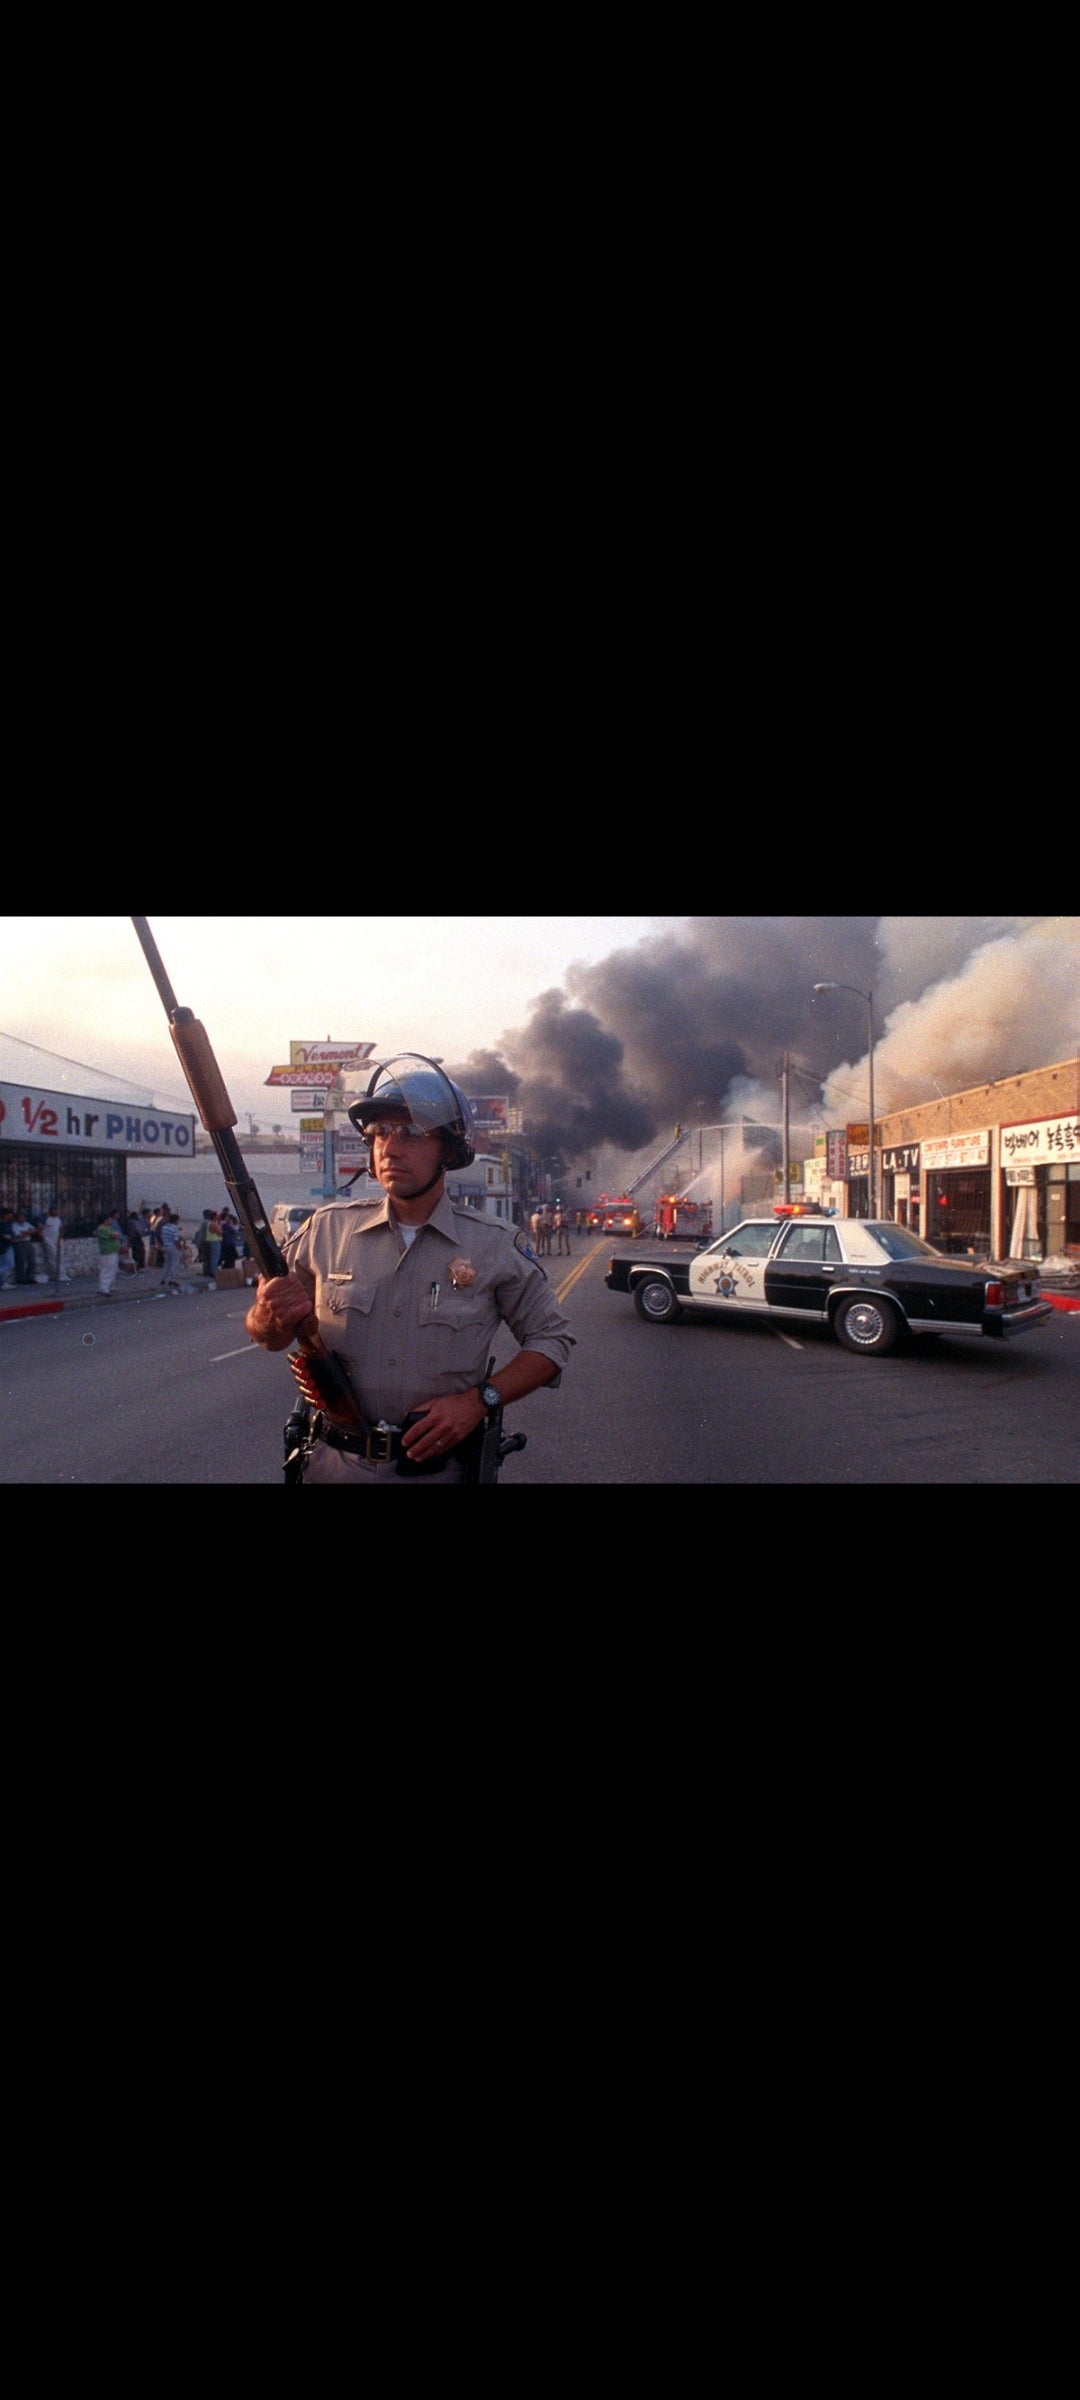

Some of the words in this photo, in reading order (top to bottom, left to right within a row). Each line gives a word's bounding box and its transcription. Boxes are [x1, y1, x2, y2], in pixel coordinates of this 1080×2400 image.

[295, 1042, 363, 1062] Vermont
[66, 1107, 100, 1137] hr
[105, 1113, 190, 1147] PHOTO
[731, 1262, 756, 1288] PATROL
